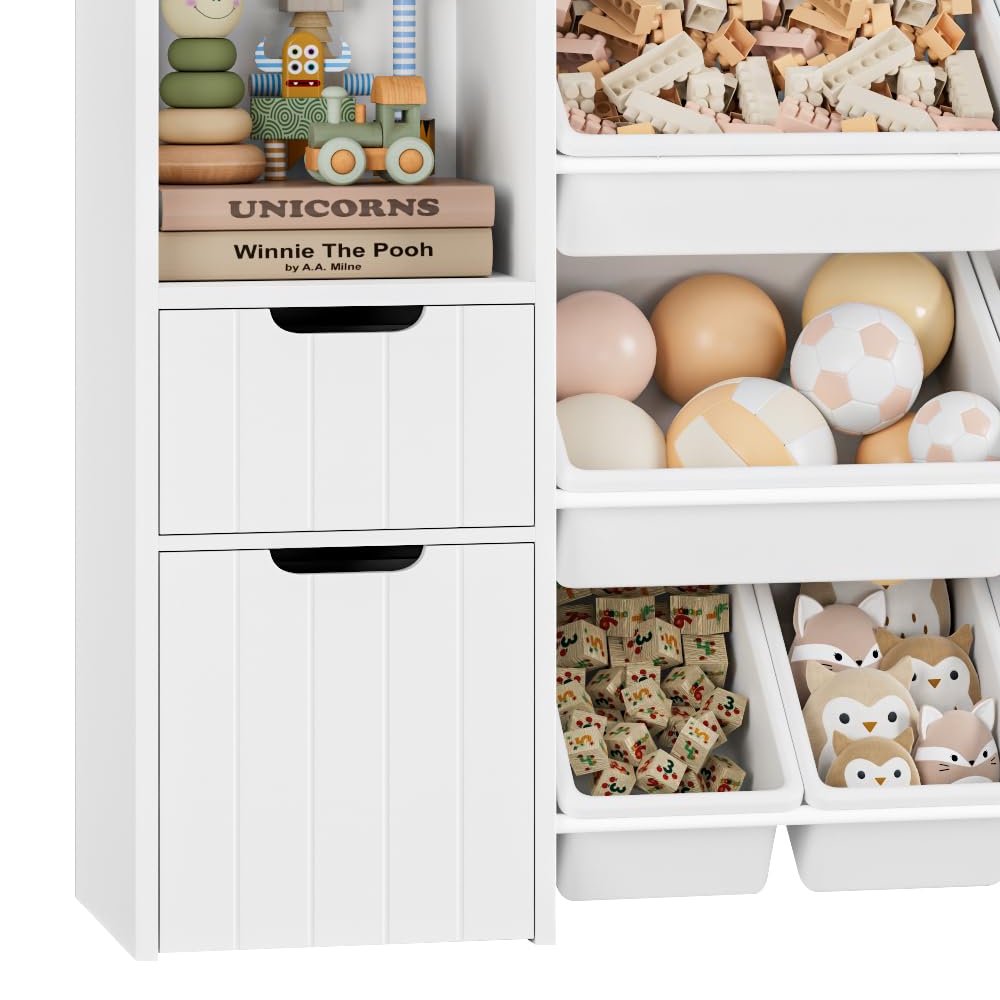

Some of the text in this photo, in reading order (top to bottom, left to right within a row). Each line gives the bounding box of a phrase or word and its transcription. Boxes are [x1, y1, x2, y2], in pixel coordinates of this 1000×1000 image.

[228, 198, 440, 219] UNICORNS
[234, 242, 434, 260] Winnie The Pooh
[285, 263, 362, 273] by A.A. Milne
